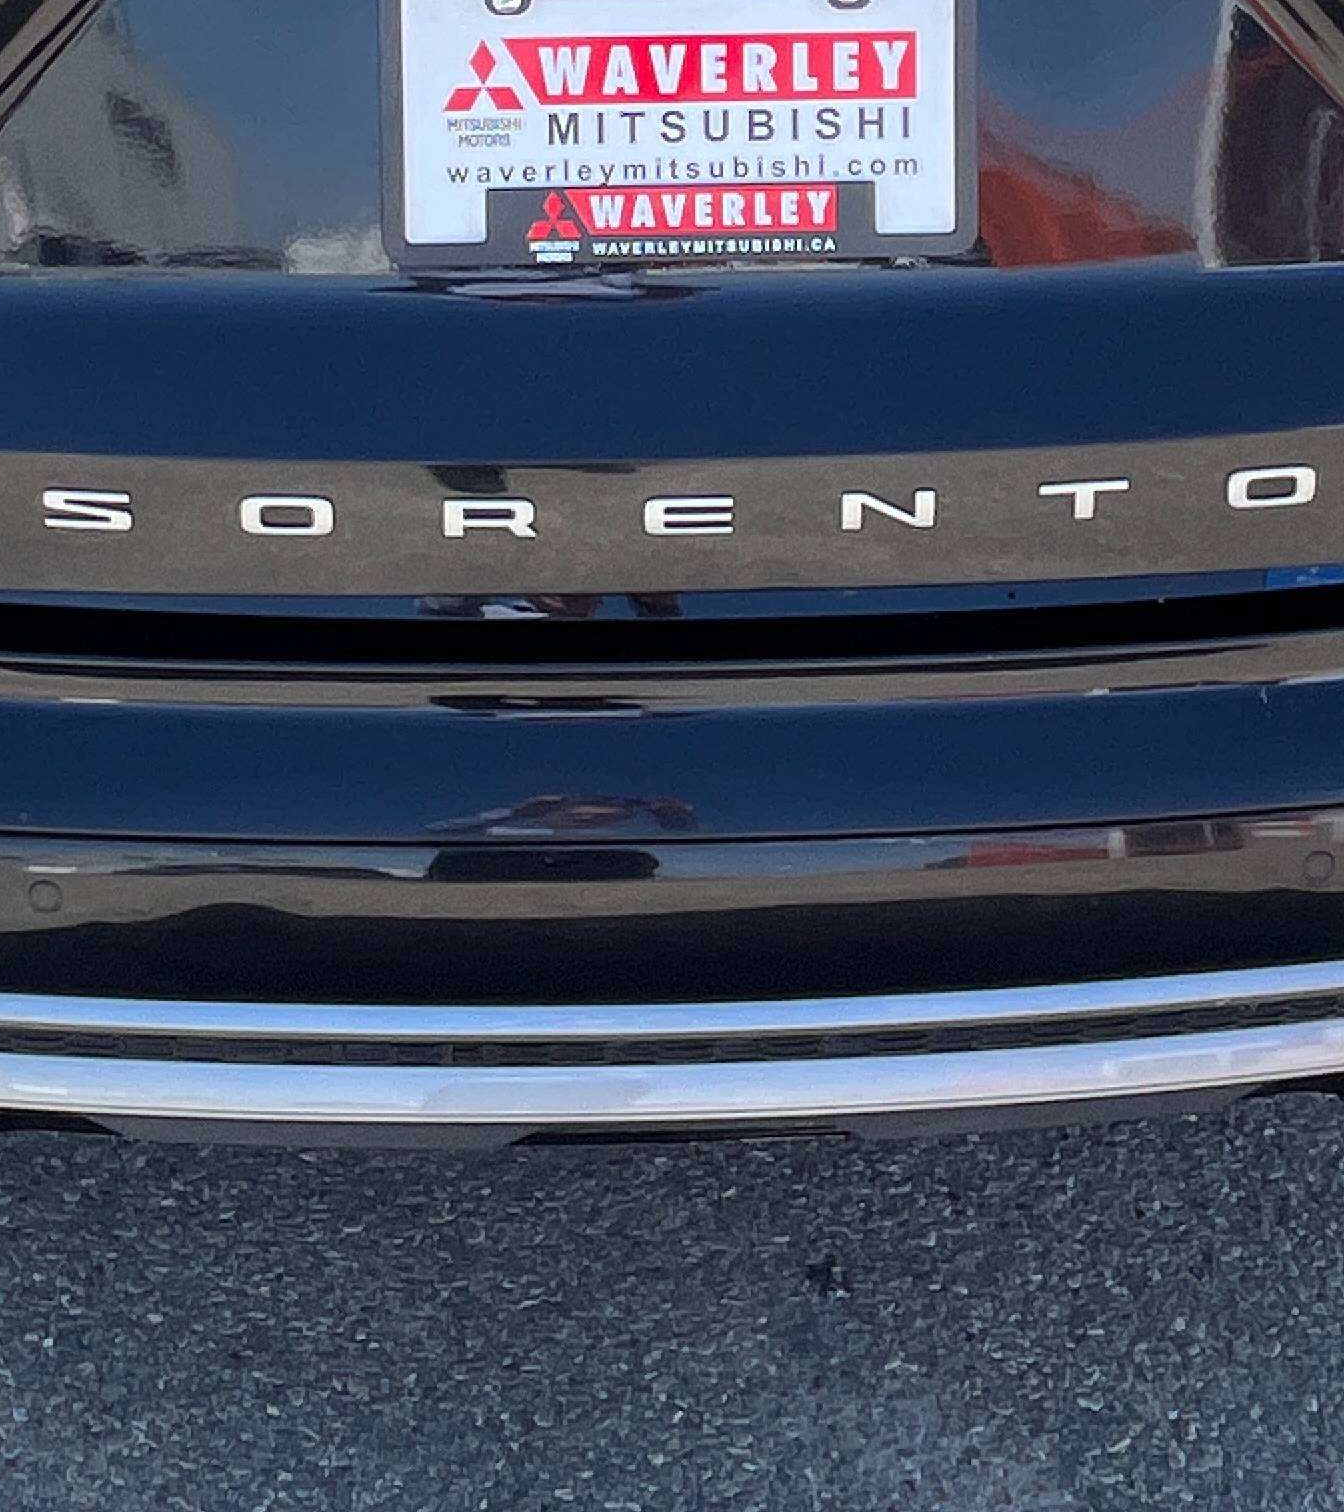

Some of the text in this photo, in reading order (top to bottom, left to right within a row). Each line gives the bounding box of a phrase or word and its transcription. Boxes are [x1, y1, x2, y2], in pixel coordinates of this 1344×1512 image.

[538, 40, 909, 97] WAVERLEY
[446, 117, 523, 131] MITSUBISHI
[458, 133, 511, 148] MOTORS
[547, 106, 910, 146] MITSUBISHI
[446, 152, 919, 188] waverleymitsubishi.com
[589, 189, 832, 230] WAVERLEY
[42, 464, 1317, 540] SORENTO
